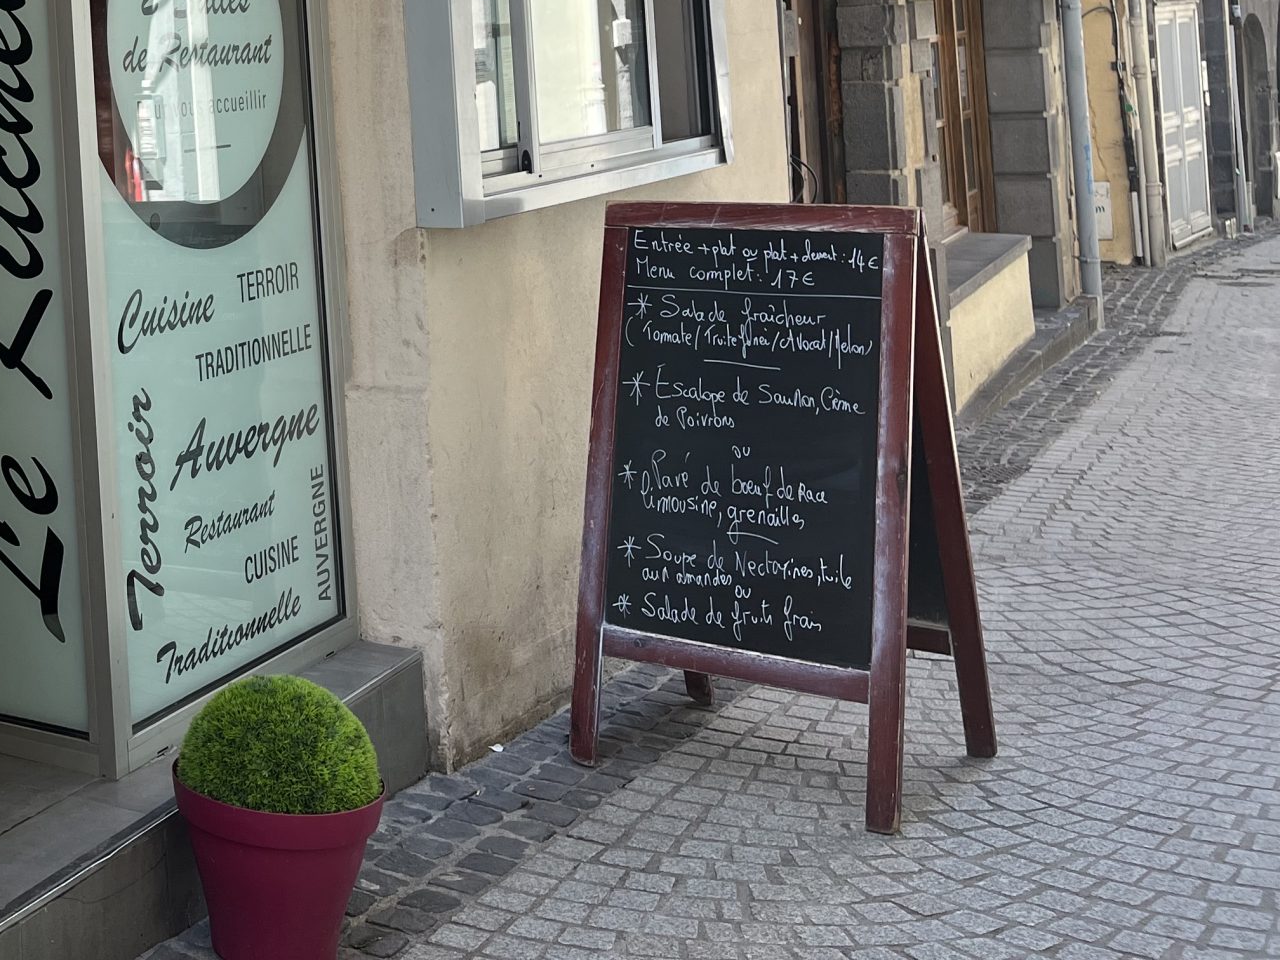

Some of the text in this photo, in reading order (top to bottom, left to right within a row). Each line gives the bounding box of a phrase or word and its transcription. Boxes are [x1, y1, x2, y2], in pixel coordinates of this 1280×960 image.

[122, 31, 273, 73] de Restaurant
[634, 229, 694, 255] Entrée
[712, 233, 737, 269] plat
[742, 247, 758, 261] ou
[763, 238, 788, 274] plat
[636, 256, 676, 280] Menu
[236, 262, 299, 303] TERROIR
[117, 288, 215, 355] Cuisine
[659, 293, 727, 323] Salade
[195, 324, 312, 382] TRADITIONNELLE
[655, 363, 726, 413] Escalope
[732, 376, 750, 406] de
[820, 386, 866, 415] Crème
[654, 405, 736, 430] de Poivrons
[170, 403, 320, 491] Auvergne
[731, 444, 751, 459] ou
[651, 449, 691, 491] Pavé
[701, 464, 721, 497] de
[776, 465, 795, 501] de
[127, 387, 165, 631] Terroir
[184, 490, 276, 554] Restaurant
[726, 504, 806, 545] grenailles
[310, 464, 332, 602] AUVERGNE
[644, 533, 698, 574] Soupe
[707, 539, 725, 573] de
[244, 535, 300, 584] CUISINE
[675, 567, 733, 587] amandes
[734, 584, 752, 599] ou
[156, 587, 302, 685] Traditionnelle
[641, 591, 700, 626] Salade
[705, 595, 726, 629] de
[783, 595, 823, 642] frais
